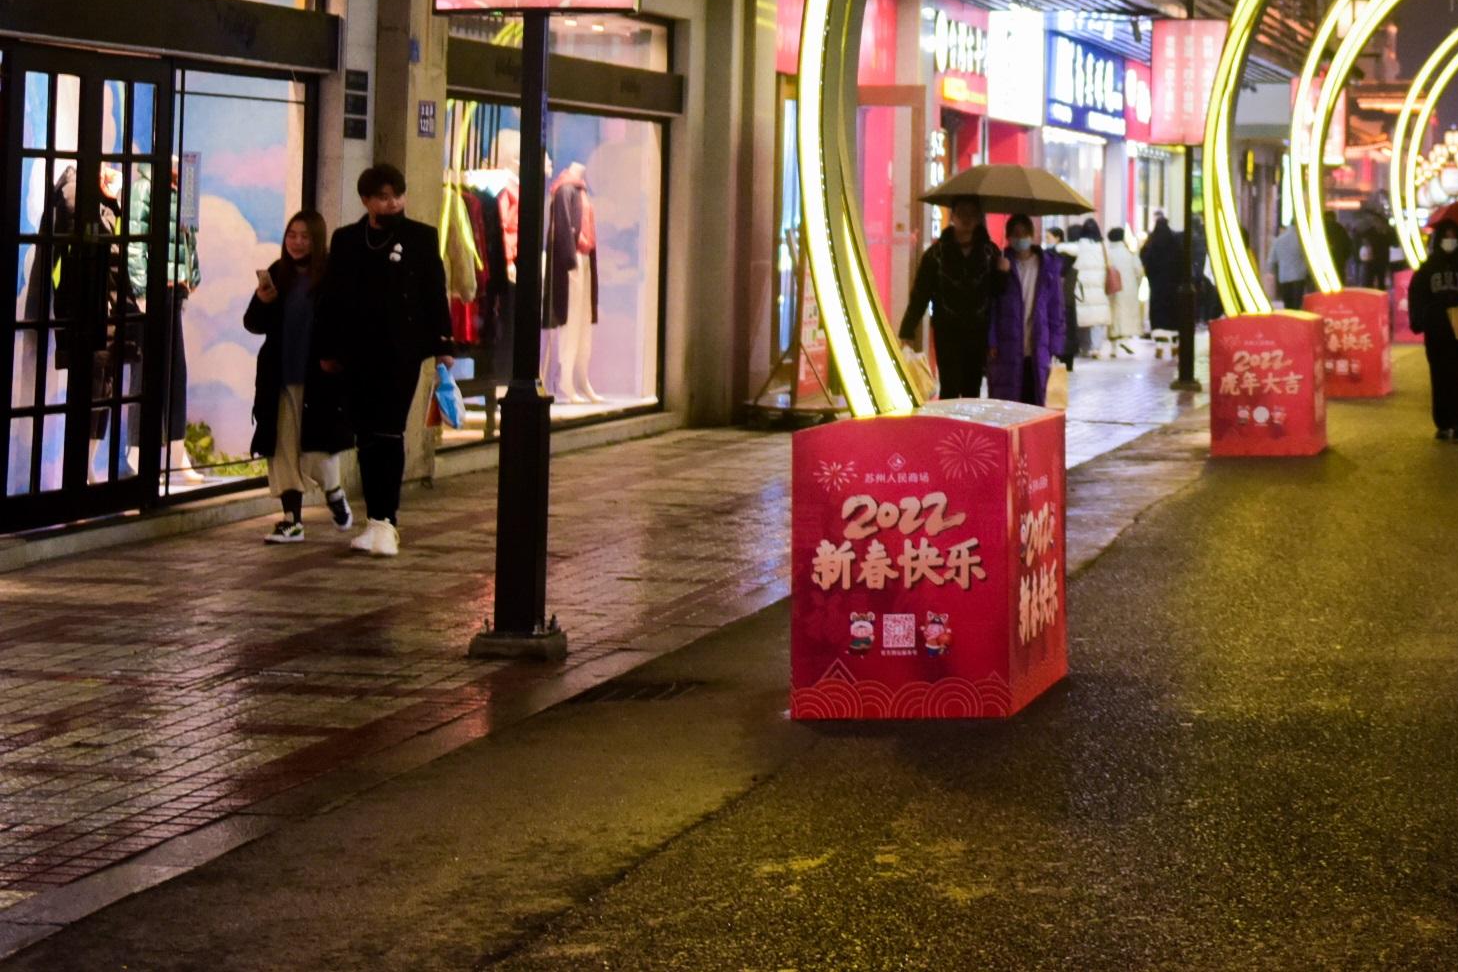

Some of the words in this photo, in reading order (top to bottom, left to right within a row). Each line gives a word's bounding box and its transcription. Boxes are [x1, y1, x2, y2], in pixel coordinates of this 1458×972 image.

[1324, 317, 1366, 333] 2022
[1326, 334, 1374, 352] 春快乐
[1233, 349, 1293, 373] 2022
[1219, 372, 1304, 396] 虎年大吉
[865, 471, 930, 484] 苏州人民商场
[842, 491, 966, 540] 2022
[811, 537, 986, 590] 新春快乐
